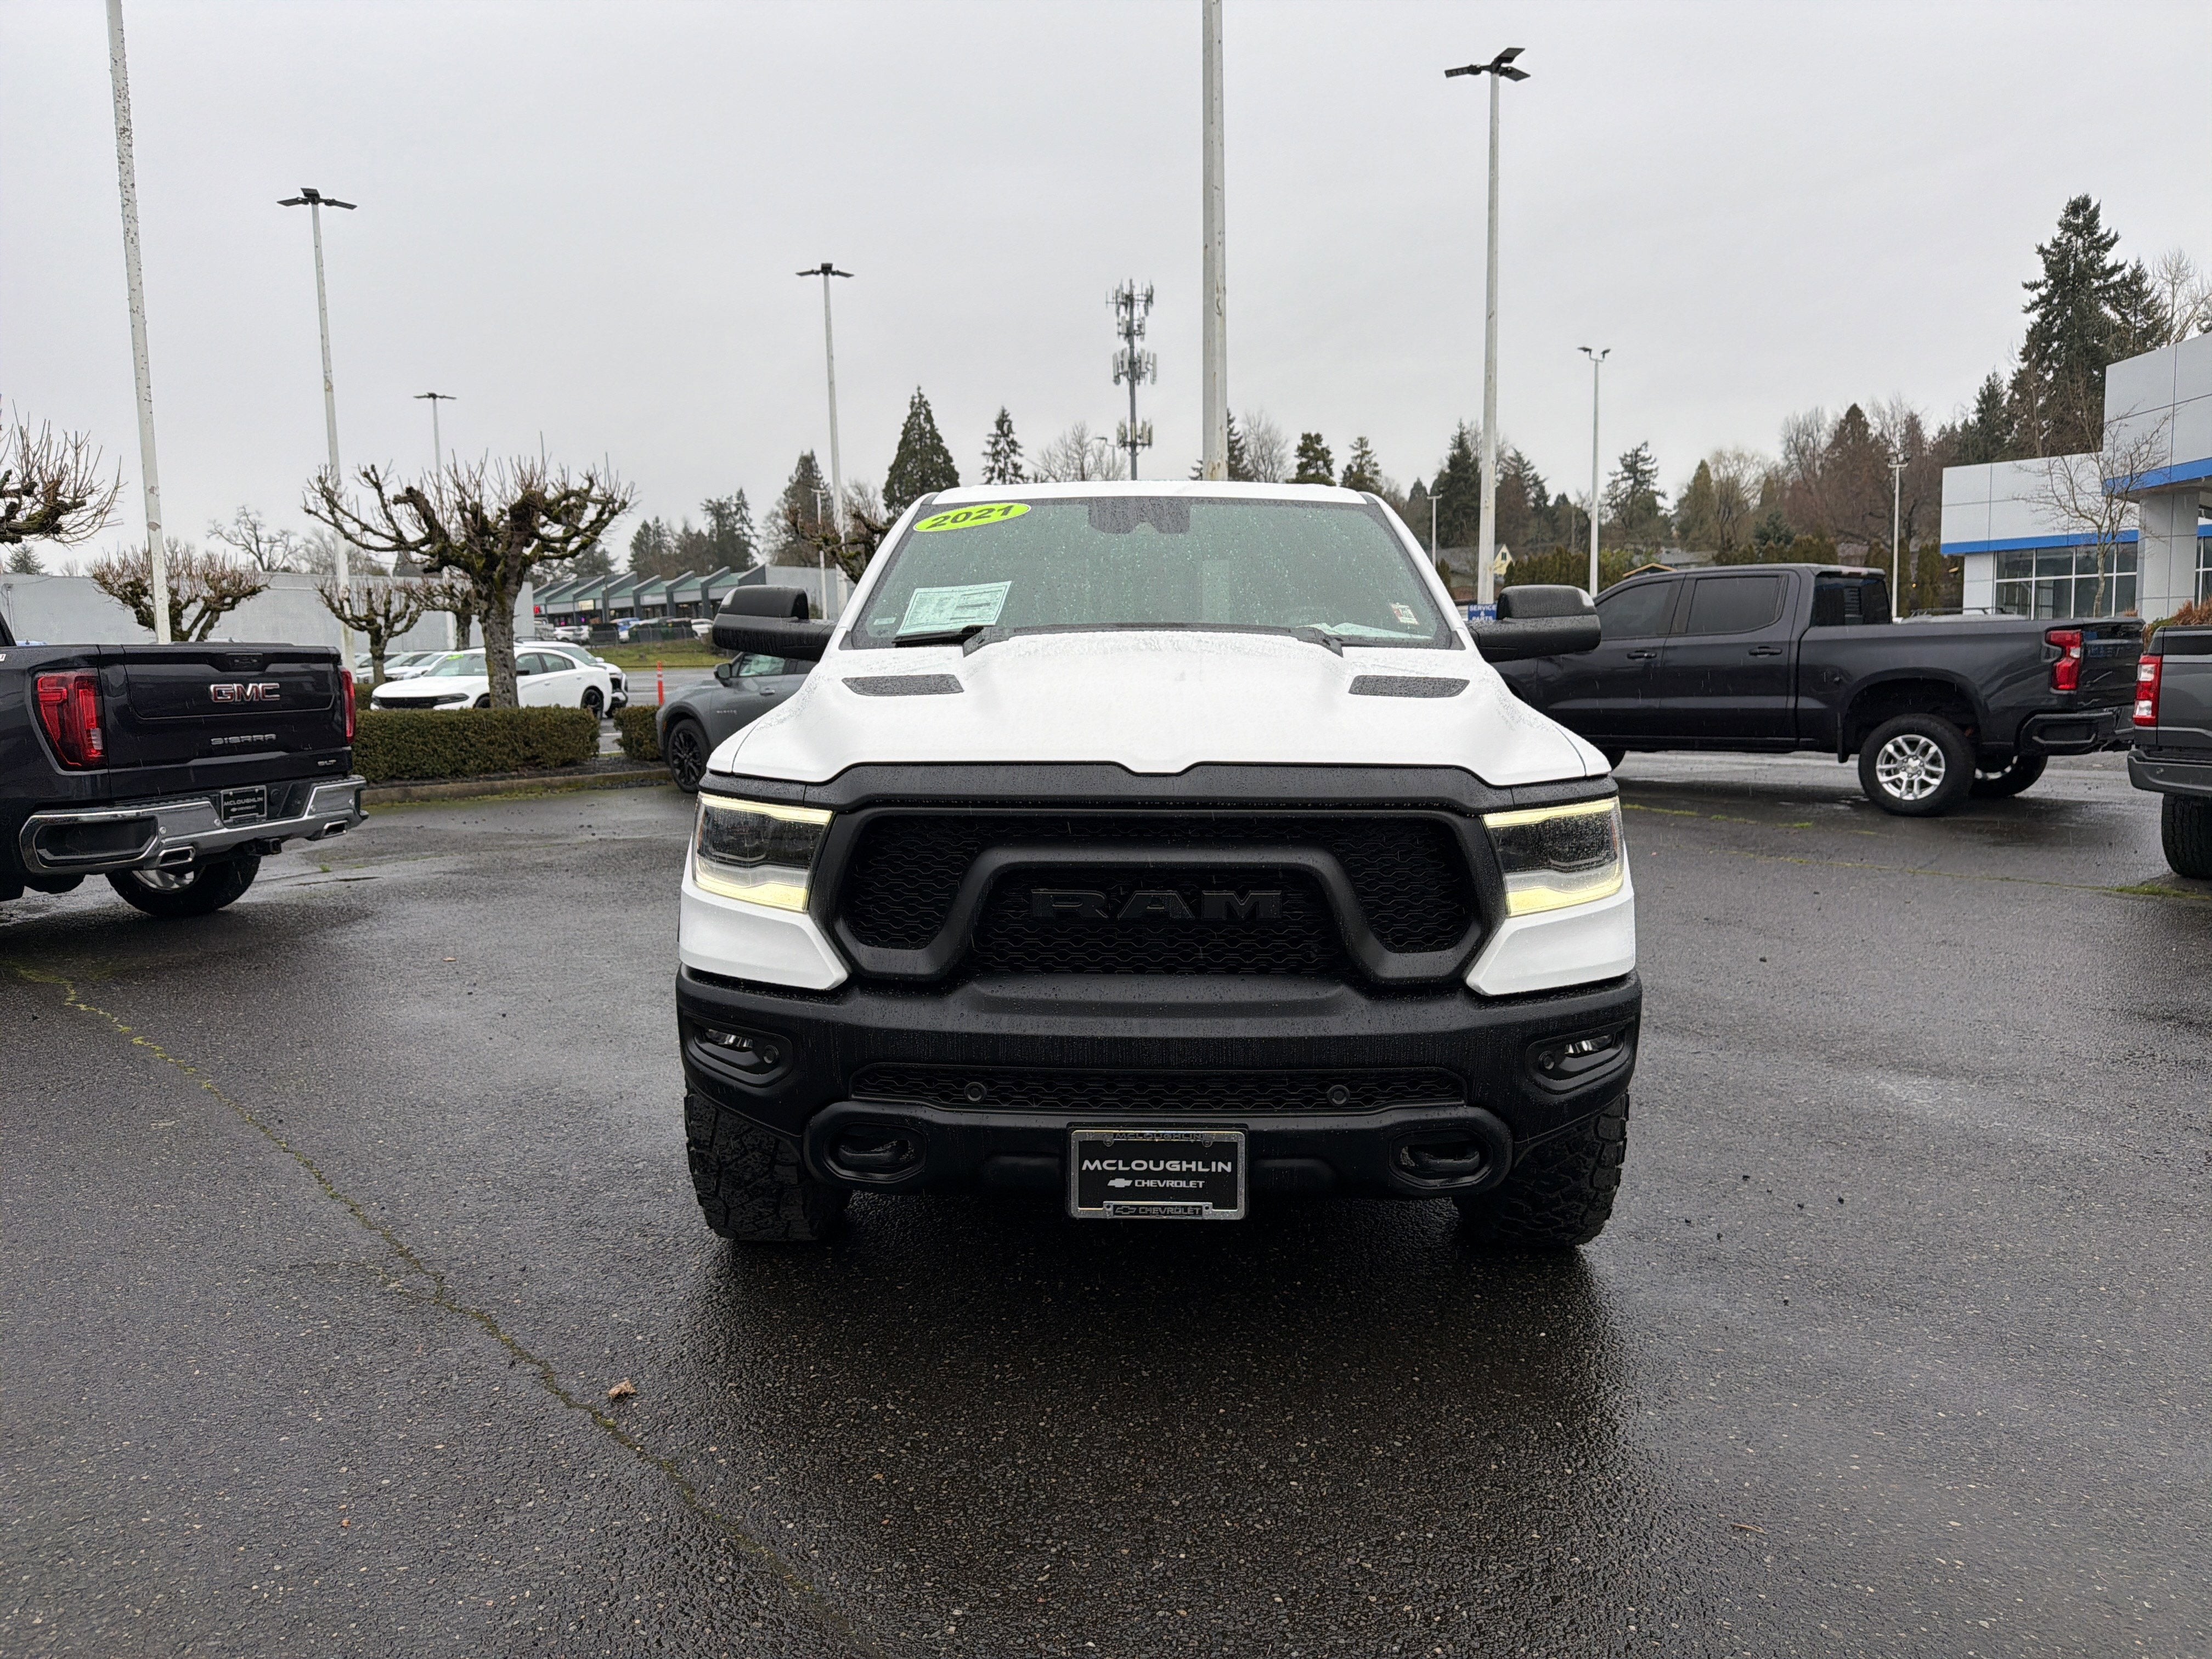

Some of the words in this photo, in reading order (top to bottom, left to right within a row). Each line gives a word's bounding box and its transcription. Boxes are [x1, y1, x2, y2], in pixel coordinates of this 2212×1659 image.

[926, 505, 1014, 529] 2021
[210, 683, 280, 703] GMC
[211, 734, 276, 745] SIERRA
[1031, 889, 1282, 920] RAM
[1081, 1159, 1232, 1173] MCLOUGHLIN
[1134, 1180, 1205, 1188] CHEVROLET
[1138, 1206, 1202, 1215] CHEVROLET
